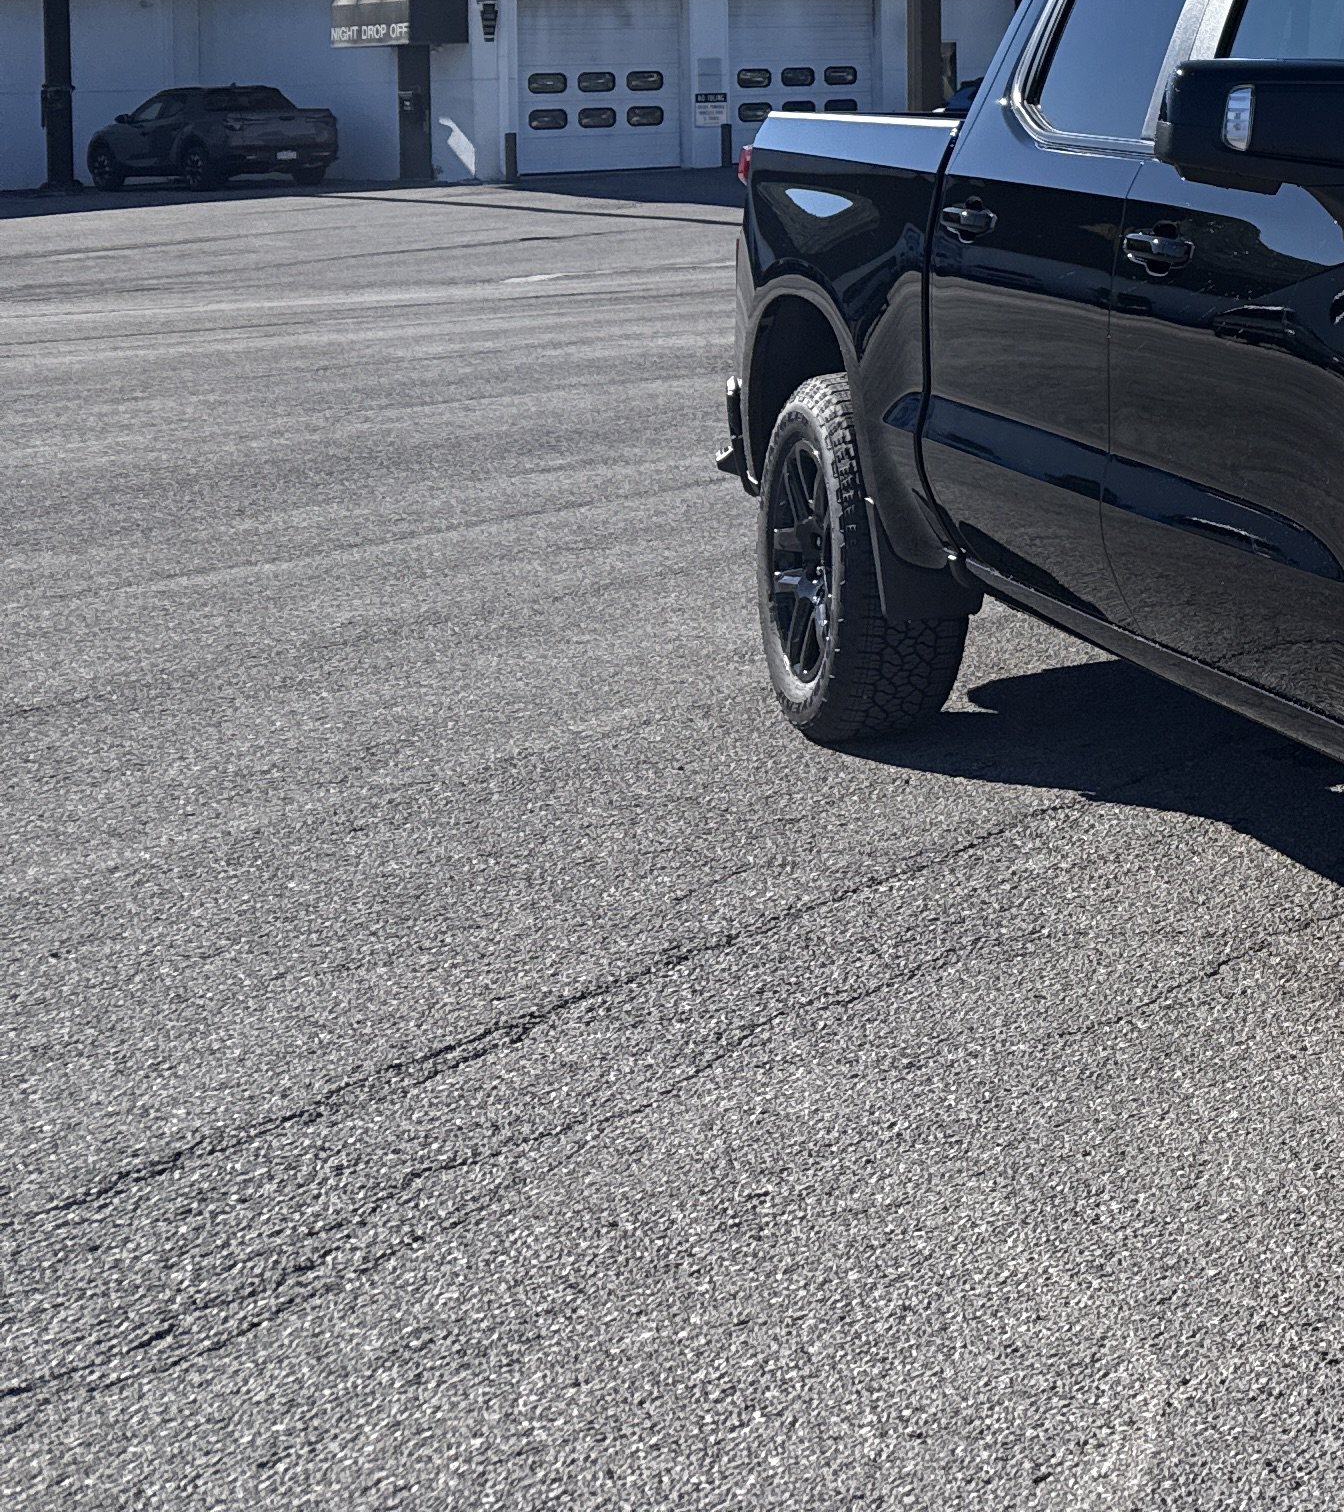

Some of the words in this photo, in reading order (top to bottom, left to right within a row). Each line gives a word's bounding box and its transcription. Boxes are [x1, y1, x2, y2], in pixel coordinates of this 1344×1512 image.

[330, 26, 358, 40] NIGHT
[361, 24, 387, 39] DROP
[390, 22, 409, 38] OFF
